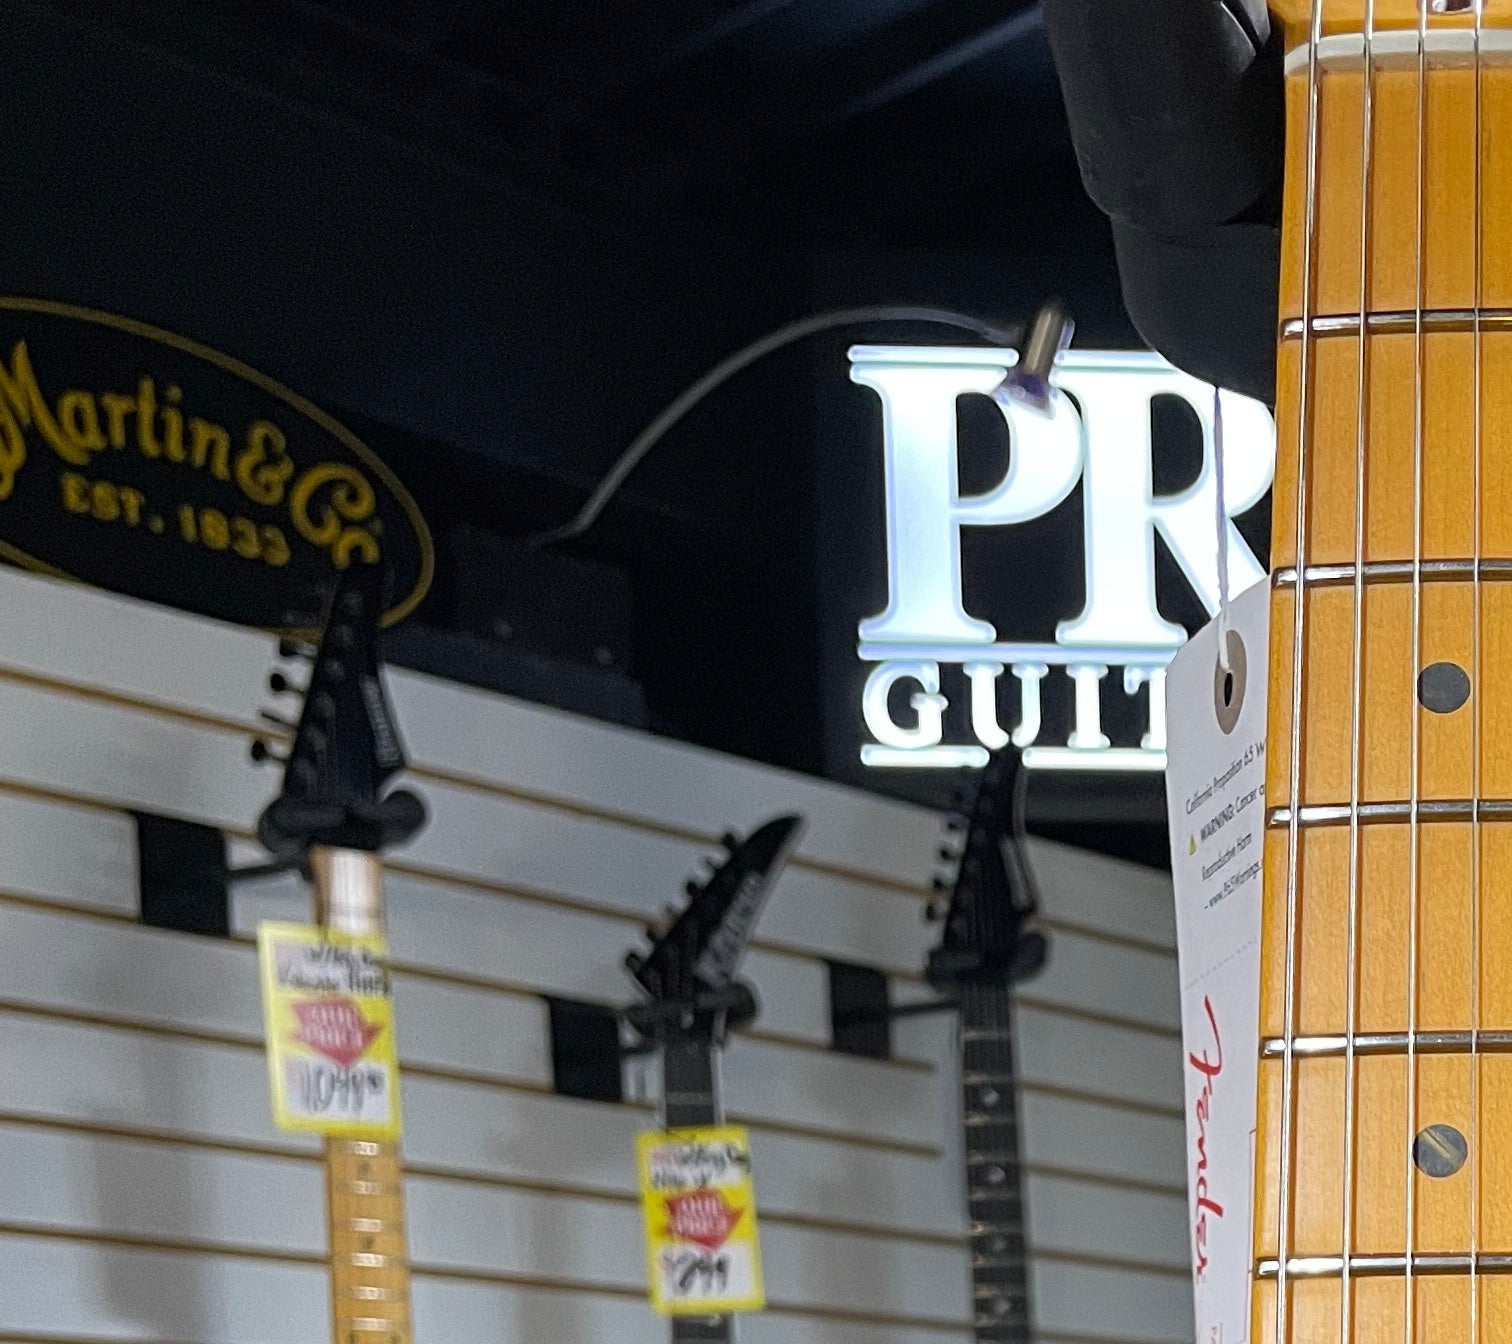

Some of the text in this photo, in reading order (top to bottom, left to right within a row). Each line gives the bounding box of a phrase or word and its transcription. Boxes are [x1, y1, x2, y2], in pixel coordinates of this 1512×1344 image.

[850, 363, 1276, 649] PR
[862, 660, 1168, 750] GUIT
[1189, 994, 1224, 1280] Fender
